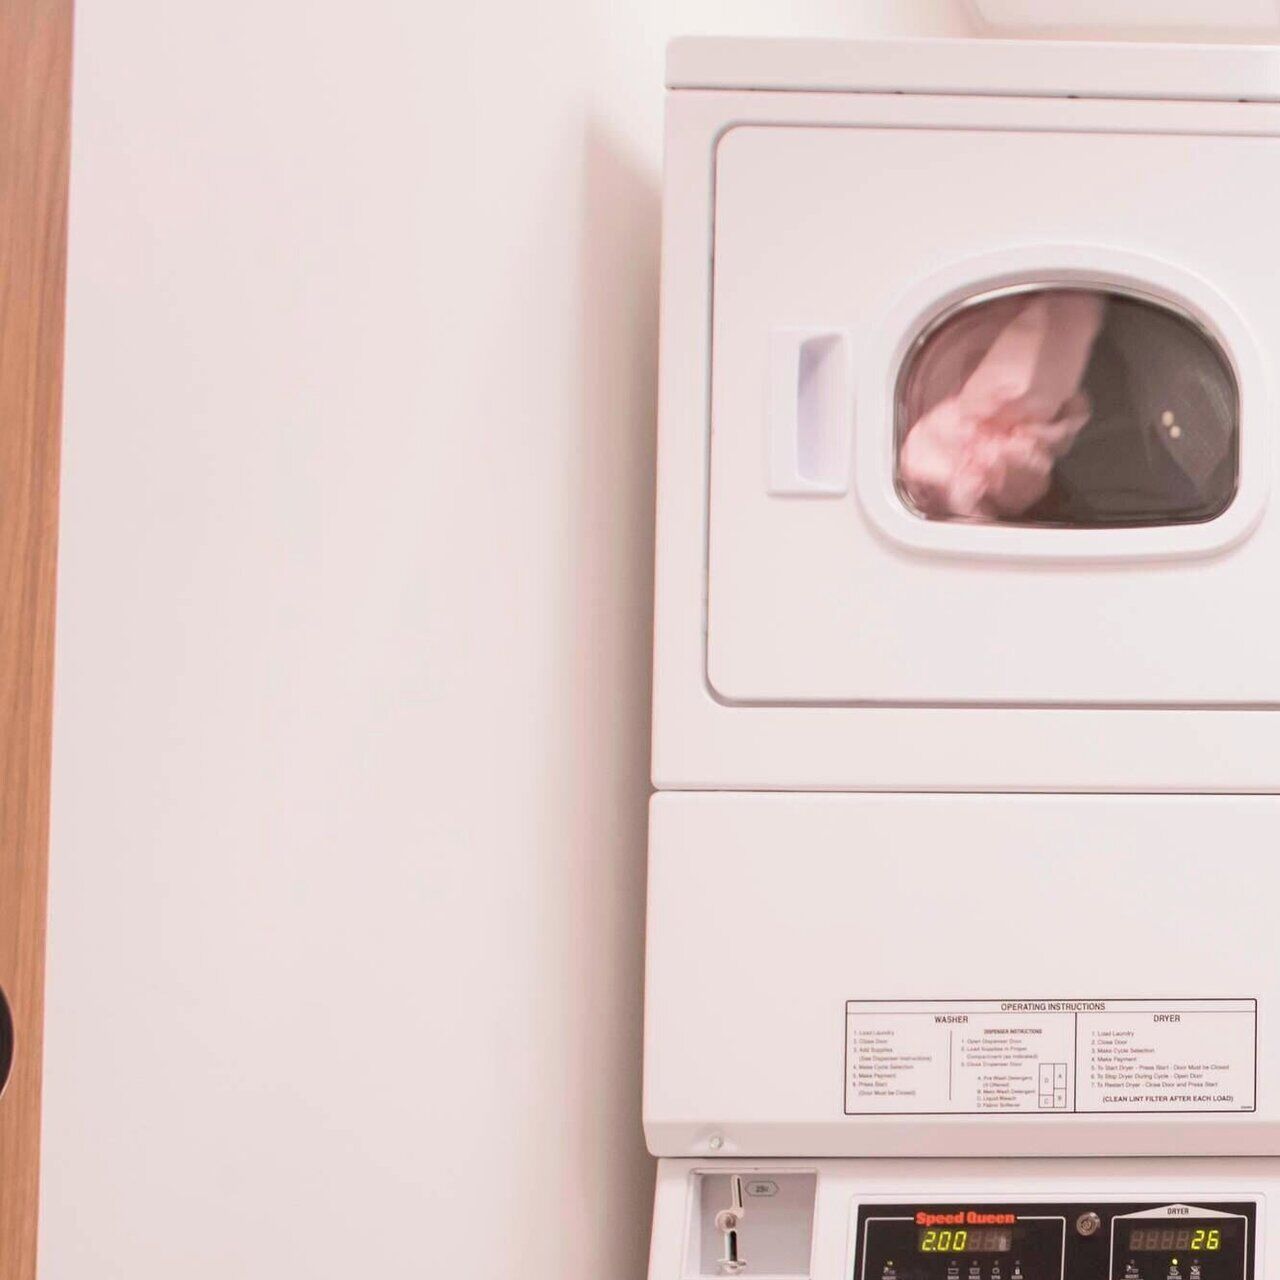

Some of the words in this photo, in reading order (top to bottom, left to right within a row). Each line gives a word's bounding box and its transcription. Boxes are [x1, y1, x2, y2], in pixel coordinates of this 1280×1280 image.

[1000, 1002, 1046, 1011] OPERATING
[1048, 1002, 1106, 1011] INSTRUCTIONS
[934, 1016, 969, 1024] WASHER
[1153, 1014, 1181, 1022] DRYER
[1166, 1207, 1189, 1215] DRYER
[915, 1211, 964, 1226] Speed
[966, 1211, 1015, 1224] Queen
[921, 1230, 968, 1251] 2.00
[1191, 1230, 1220, 1250] 26
